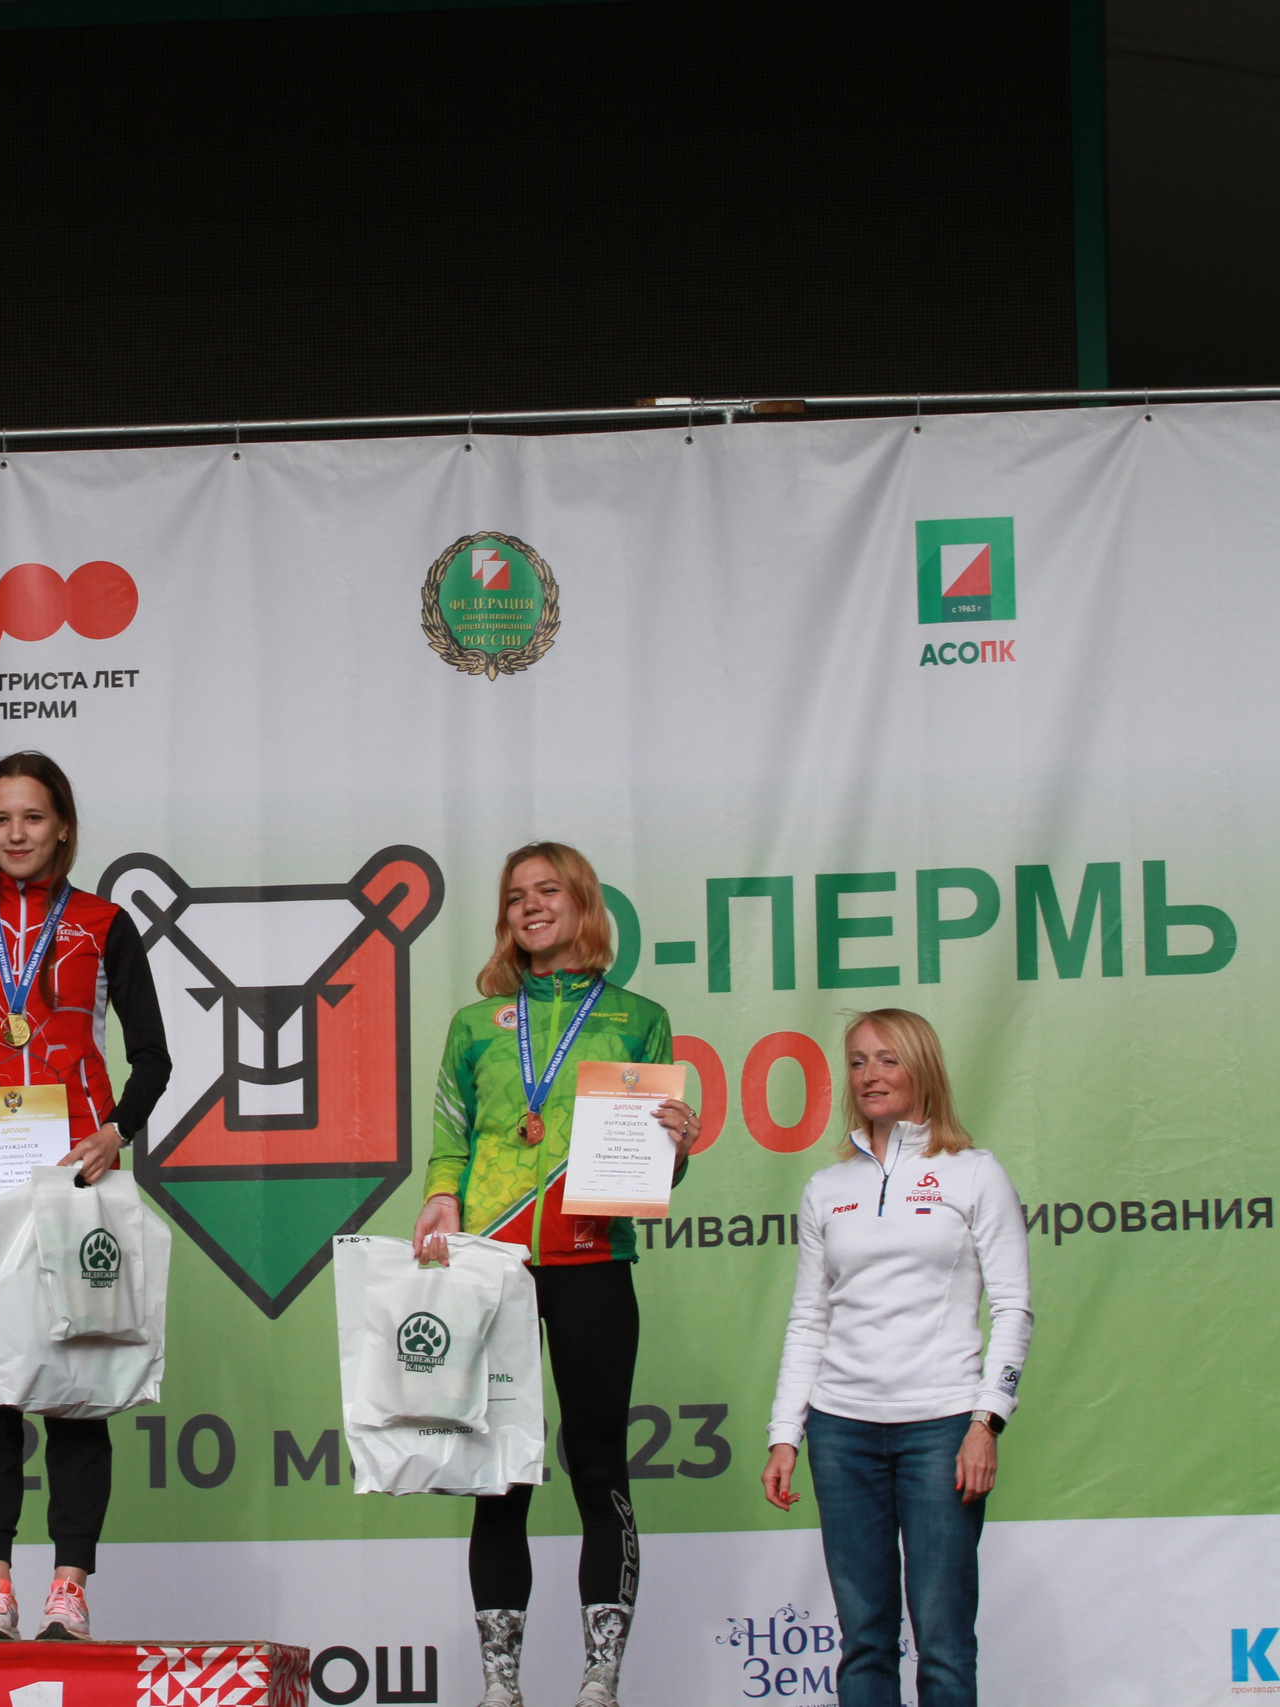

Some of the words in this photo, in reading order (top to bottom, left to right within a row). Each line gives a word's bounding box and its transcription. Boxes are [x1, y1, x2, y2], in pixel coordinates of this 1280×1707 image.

[449, 597, 535, 610] ФЕДЕРАЦИЯ
[958, 605, 976, 613] 1963
[462, 612, 523, 622] спортивного
[454, 623, 532, 633] ориентирования
[463, 634, 523, 646] РОССИИ
[919, 640, 1017, 667] АСОПК
[93, 669, 140, 689] ЛЕТ
[1, 1127, 31, 1135] ДИПЛОМ
[905, 1195, 943, 1203] RUSSIA
[832, 1203, 859, 1214] PERM
[398, 1353, 445, 1365] МЕДВЕЖИЙ
[406, 1363, 433, 1373] КЛЮЧ
[418, 1427, 453, 1437] ПЕРМЬ
[135, 1413, 236, 1489] 10
